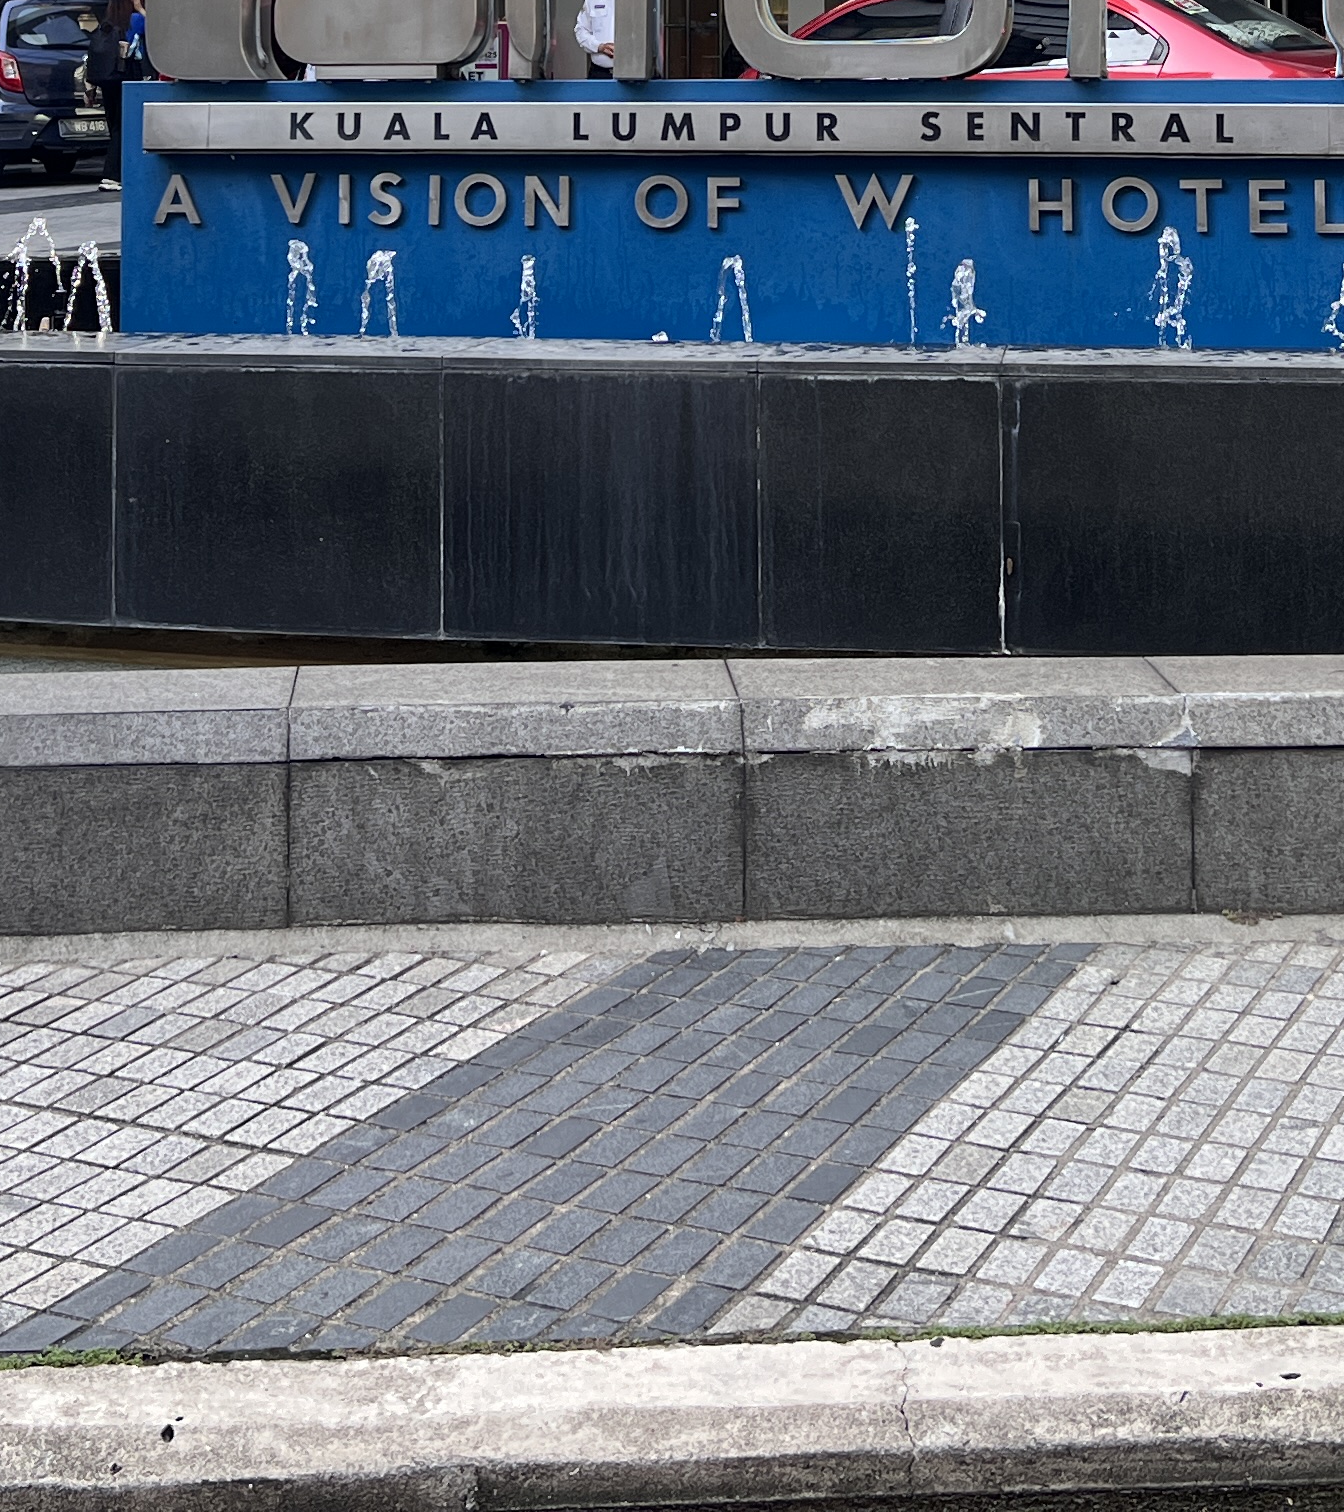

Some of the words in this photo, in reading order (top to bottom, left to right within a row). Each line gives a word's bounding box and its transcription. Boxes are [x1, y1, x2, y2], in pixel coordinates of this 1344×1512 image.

[289, 112, 498, 141] KUALA
[572, 112, 840, 142] LUMPUR
[920, 112, 1234, 144] SENTRAL
[153, 174, 202, 225] A
[269, 172, 570, 228] VISION
[633, 175, 742, 229] OF
[834, 174, 914, 230] W
